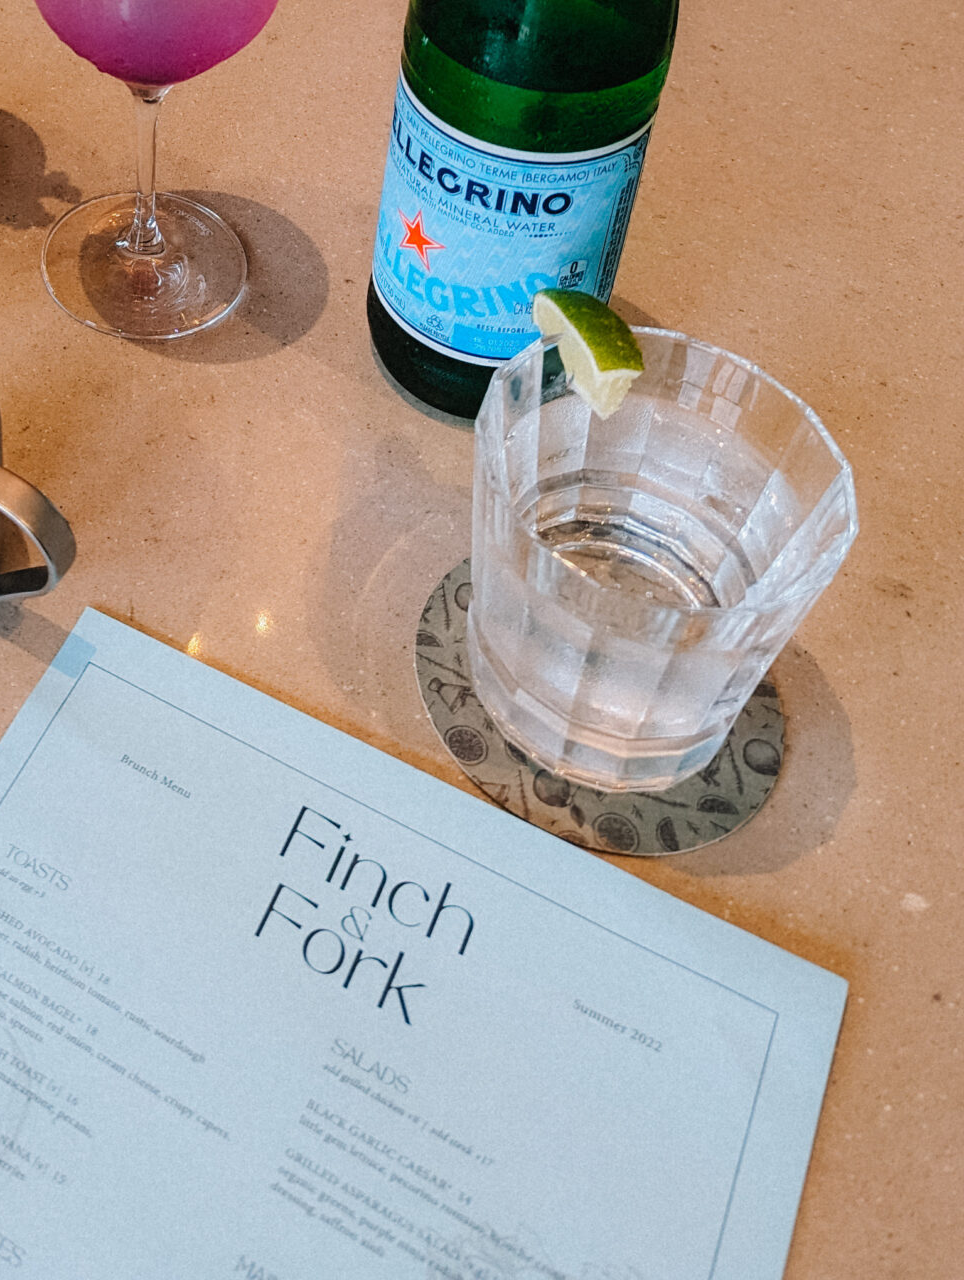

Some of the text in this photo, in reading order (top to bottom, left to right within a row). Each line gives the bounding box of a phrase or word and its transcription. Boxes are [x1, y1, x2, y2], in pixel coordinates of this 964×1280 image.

[419, 127, 476, 169] PELLEGRINO
[480, 163, 517, 181] TERME
[522, 170, 590, 184] (BERGAMO)
[593, 161, 617, 177] ITALY
[396, 154, 556, 233] NATURAL MINERAL WATER
[487, 227, 515, 238] ADDED
[569, 261, 579, 274] 0
[118, 753, 194, 800] Brunch Menu
[2, 842, 73, 892] TOASTS
[279, 805, 476, 956] Finch
[23, 926, 80, 966] AVOCADO
[340, 905, 374, 942] &
[10, 938, 45, 964] radish,
[43, 957, 88, 990] heirloom
[254, 883, 427, 1026] Fork
[45, 1018, 65, 1036] red
[571, 996, 664, 1054] Summer 2022
[7, 1054, 47, 1085] TOAST
[329, 1035, 413, 1095] SALADS
[298, 1113, 324, 1136] little
[305, 1097, 348, 1131] BLACK
[346, 1122, 396, 1160] GARLIC
[283, 1145, 339, 1186] GRILLED
[339, 1179, 415, 1234] ASPARAGUS
